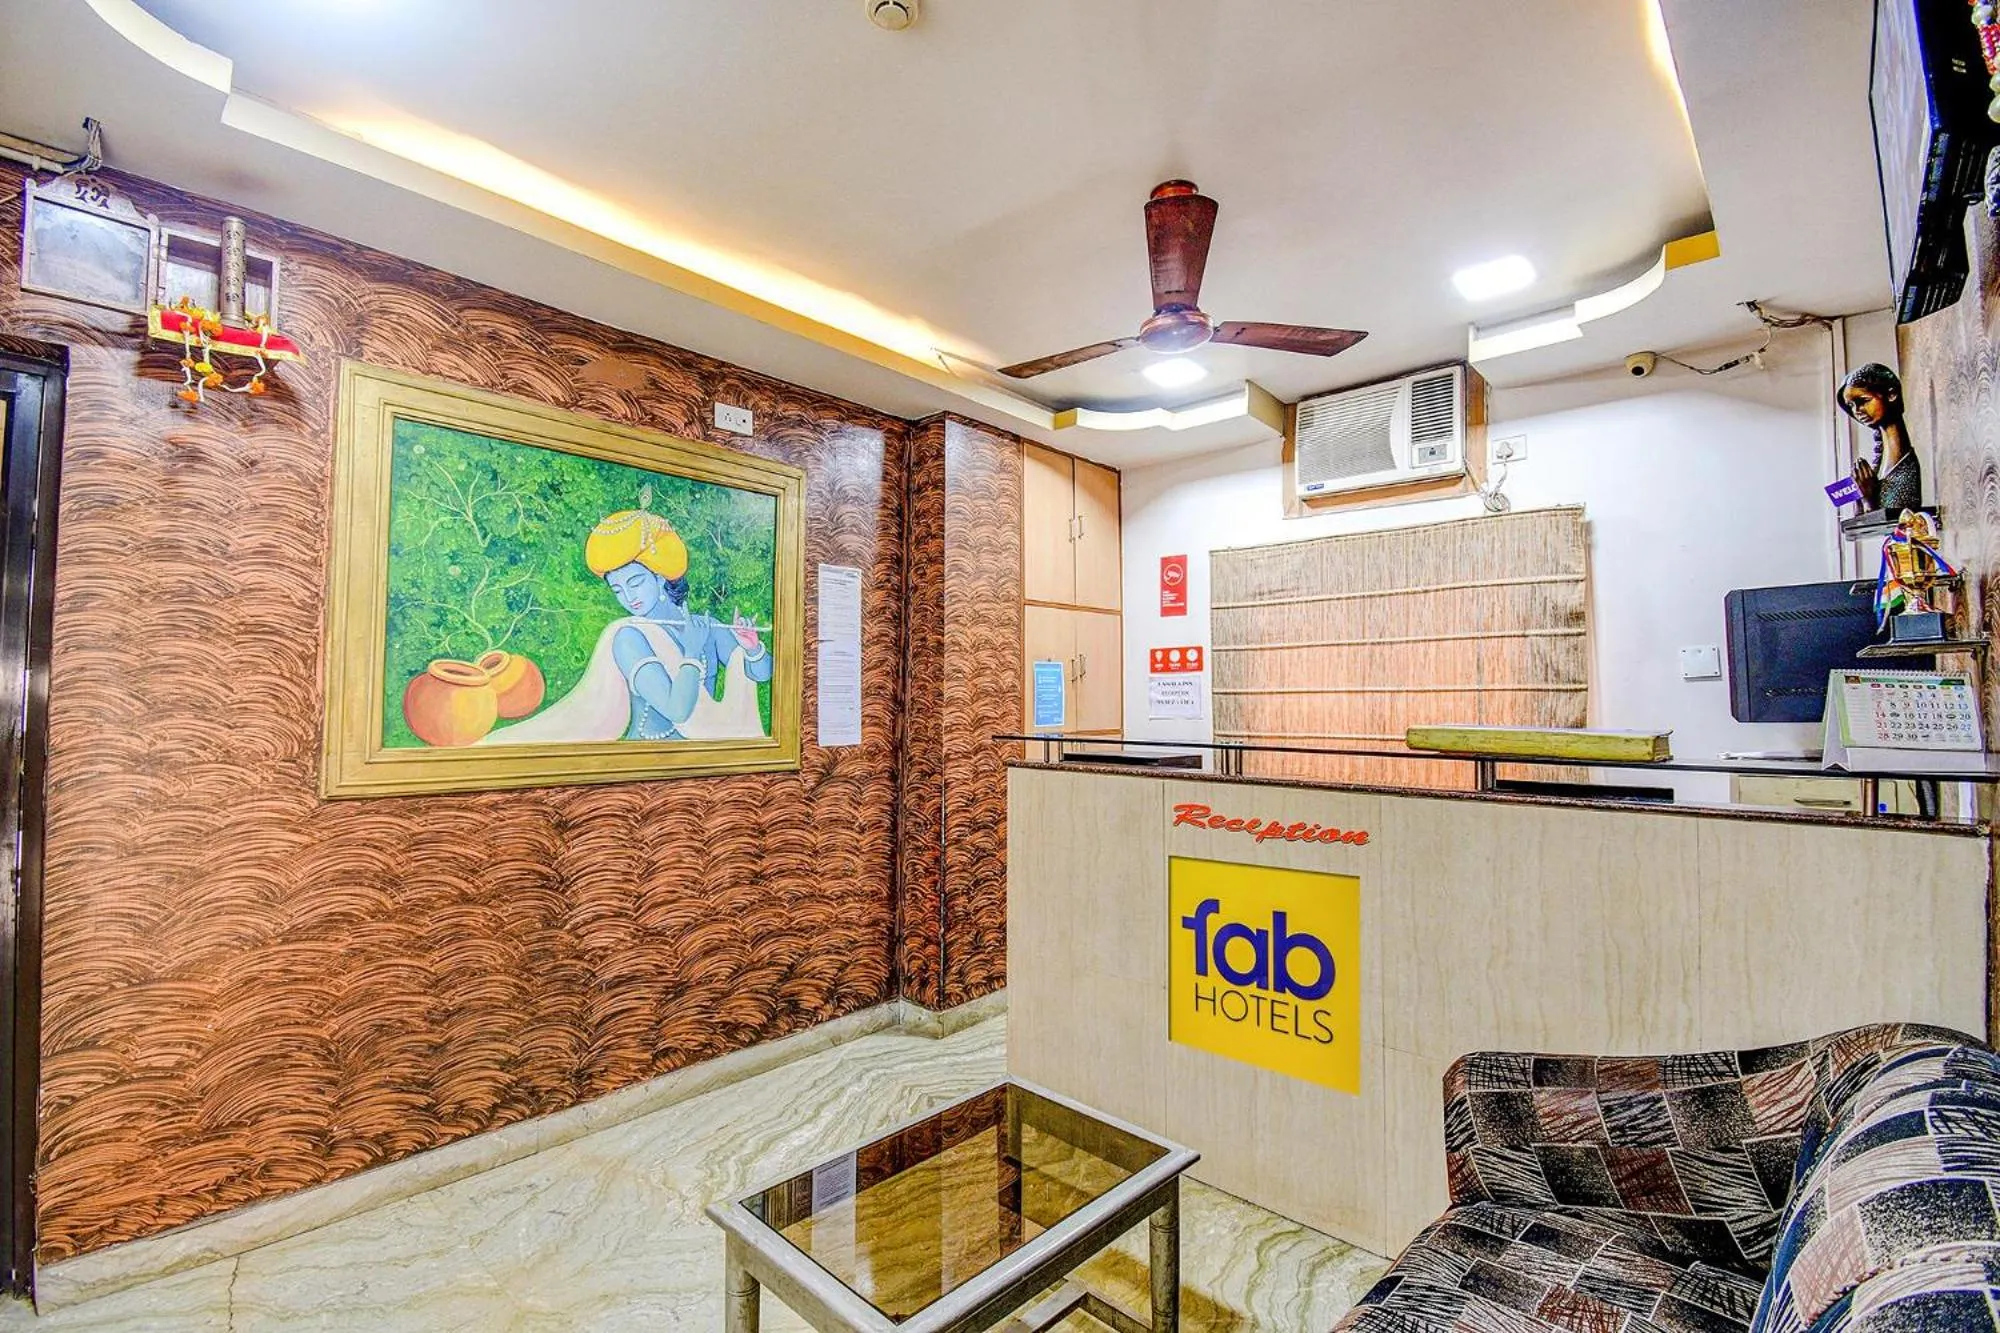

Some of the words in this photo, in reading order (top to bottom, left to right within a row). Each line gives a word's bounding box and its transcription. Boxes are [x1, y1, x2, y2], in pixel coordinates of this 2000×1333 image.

[1830, 483, 1859, 499] WELC
[1173, 803, 1370, 846] Reception
[1181, 898, 1336, 1001] fab
[1195, 982, 1334, 1044] HOTELS
